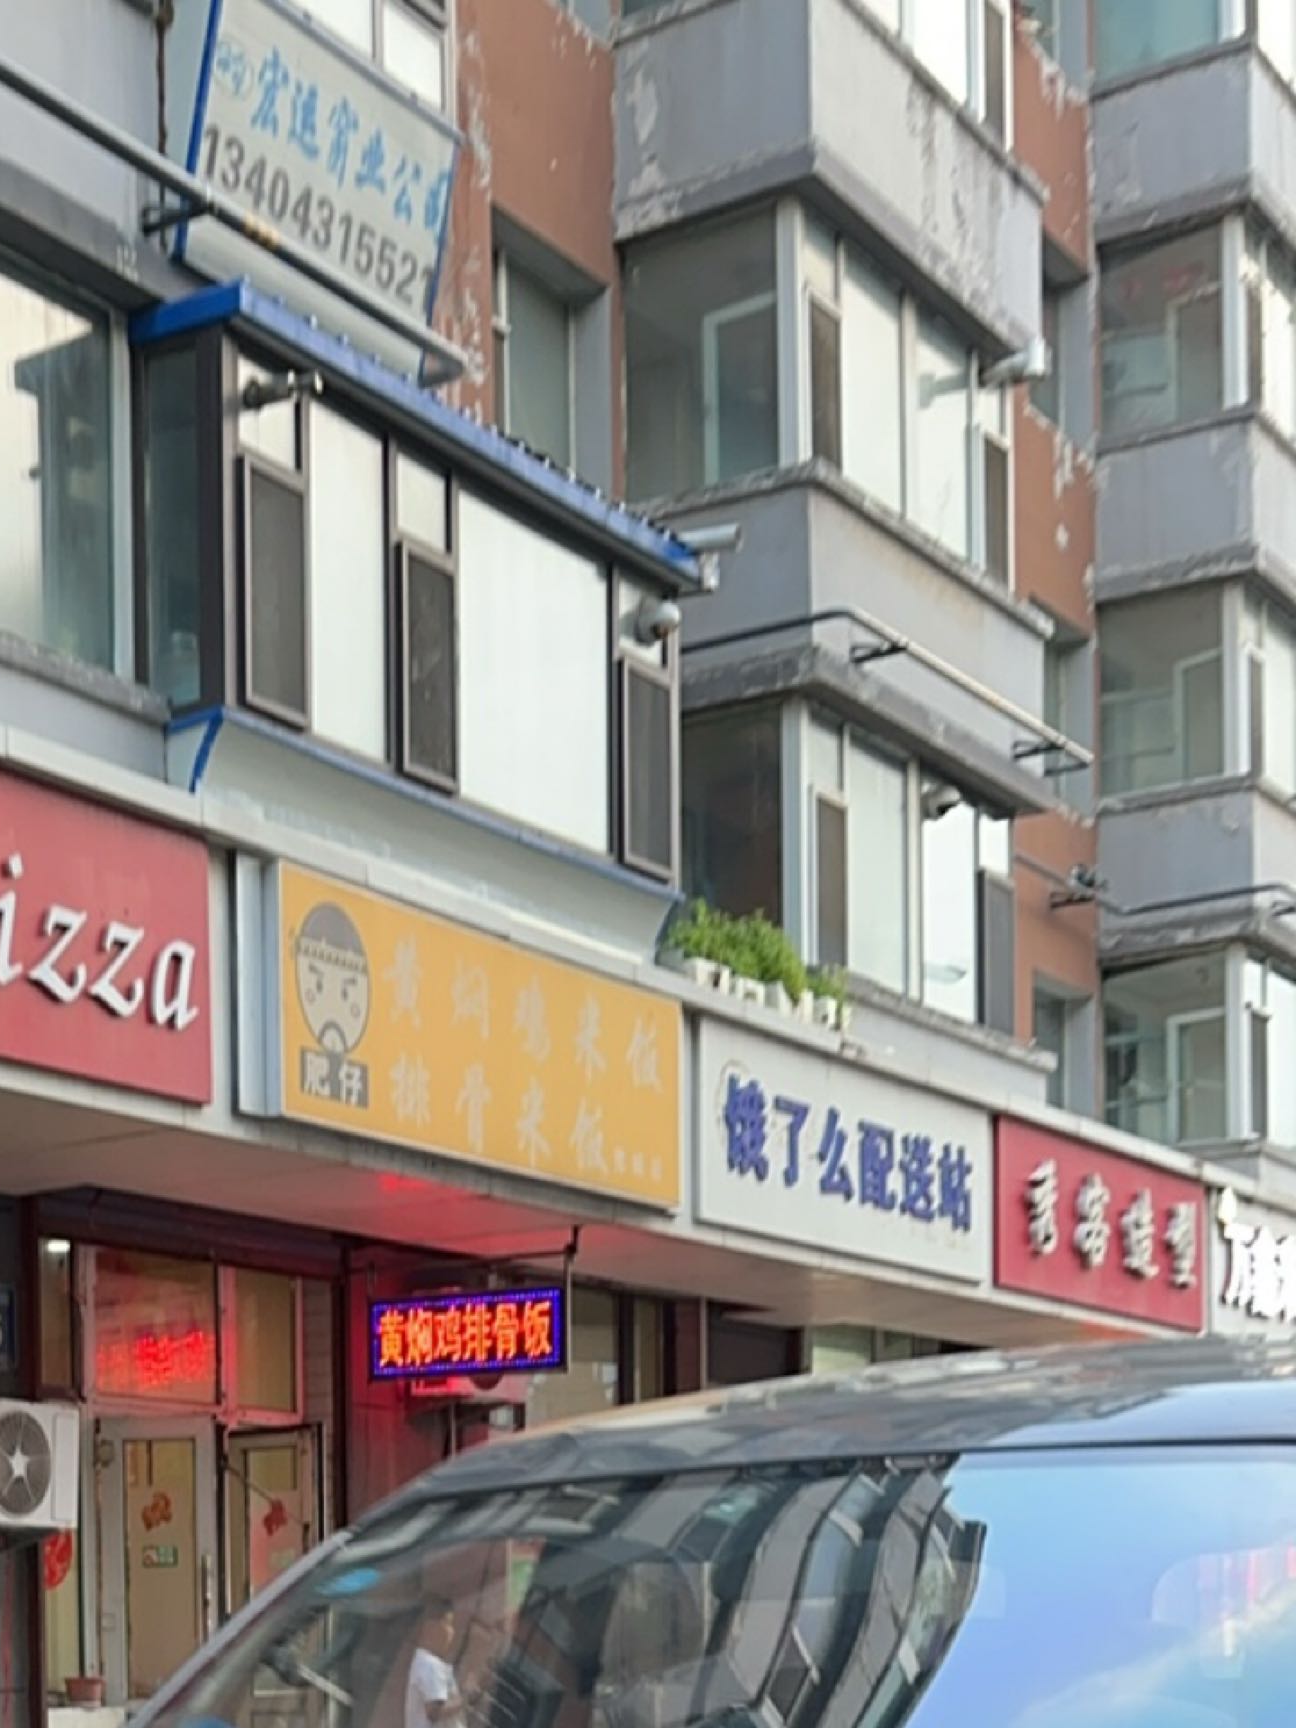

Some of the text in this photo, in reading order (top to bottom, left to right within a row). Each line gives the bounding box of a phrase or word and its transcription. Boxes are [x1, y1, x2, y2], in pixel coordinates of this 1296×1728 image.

[724, 1073, 973, 1233] 饿了么配送站
[378, 1299, 553, 1367] 黄焖鸡排骨饭
